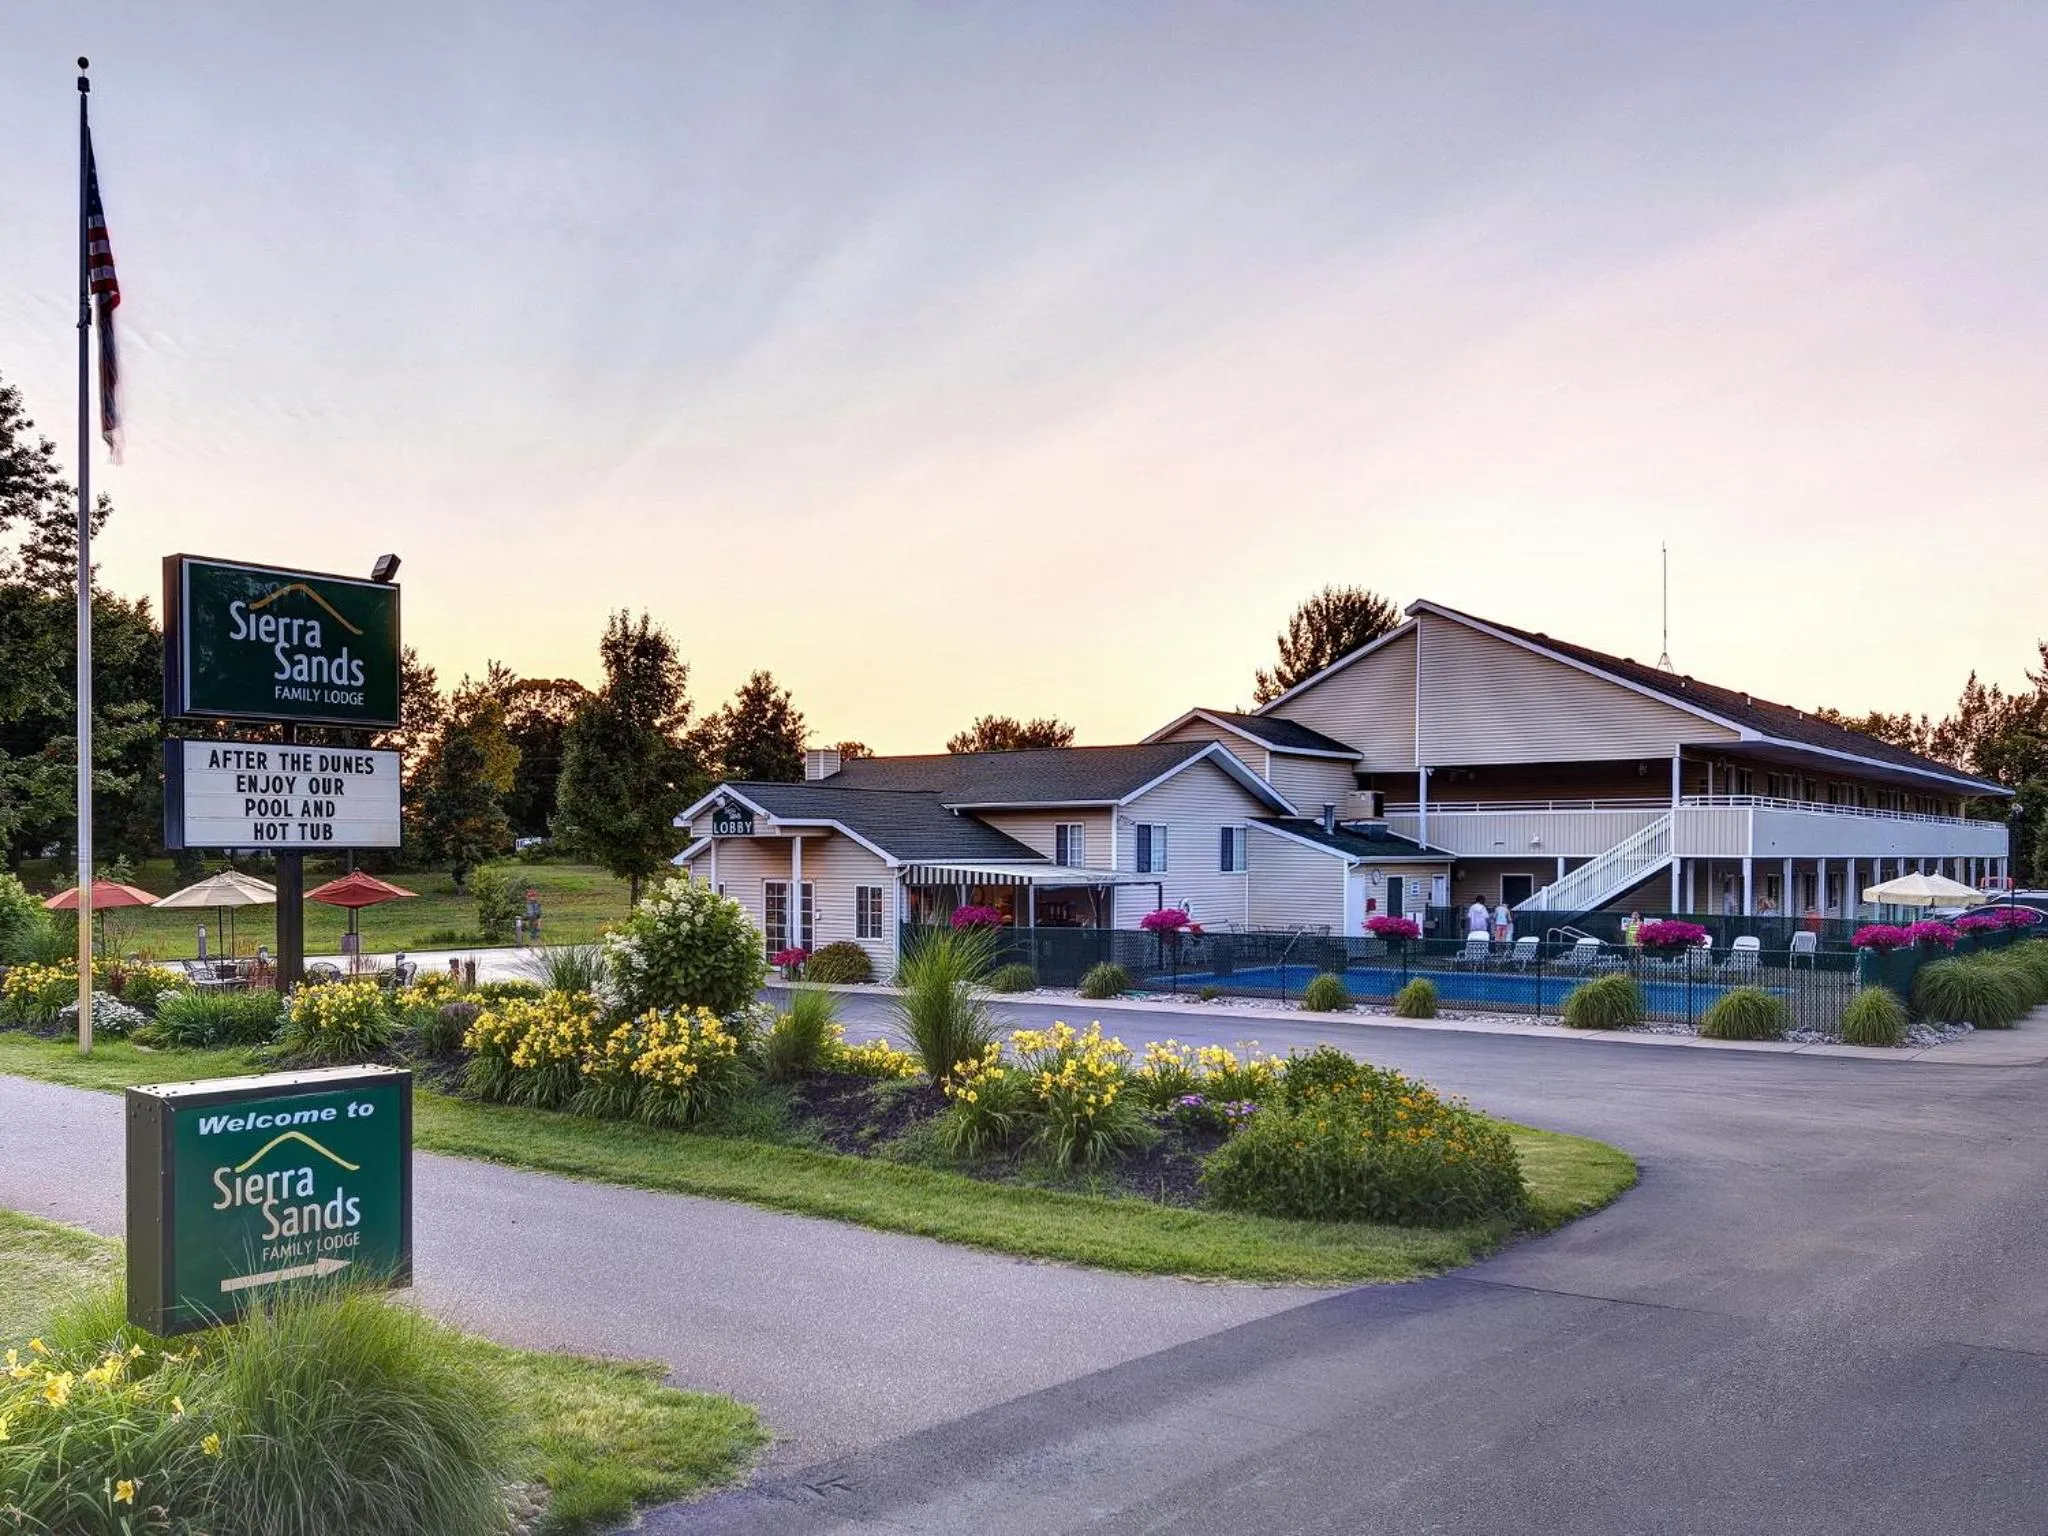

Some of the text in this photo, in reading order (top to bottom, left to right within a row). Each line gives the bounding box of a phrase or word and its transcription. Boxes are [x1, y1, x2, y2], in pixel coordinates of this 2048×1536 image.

[229, 601, 321, 648] Sierra
[274, 642, 365, 686] Sands
[275, 686, 364, 705] FAMILY LODGE
[209, 749, 374, 775] AFTER THE DUNES
[236, 775, 344, 795] ENJOY OUR
[245, 799, 335, 818] POOL AND
[254, 823, 333, 841] HOT TUB
[713, 821, 752, 834] LOBBY
[199, 1101, 374, 1135] Welcome to
[213, 1166, 313, 1210] Sierra
[262, 1186, 360, 1241] Sands
[263, 1231, 360, 1261] FAMILY LODGE
